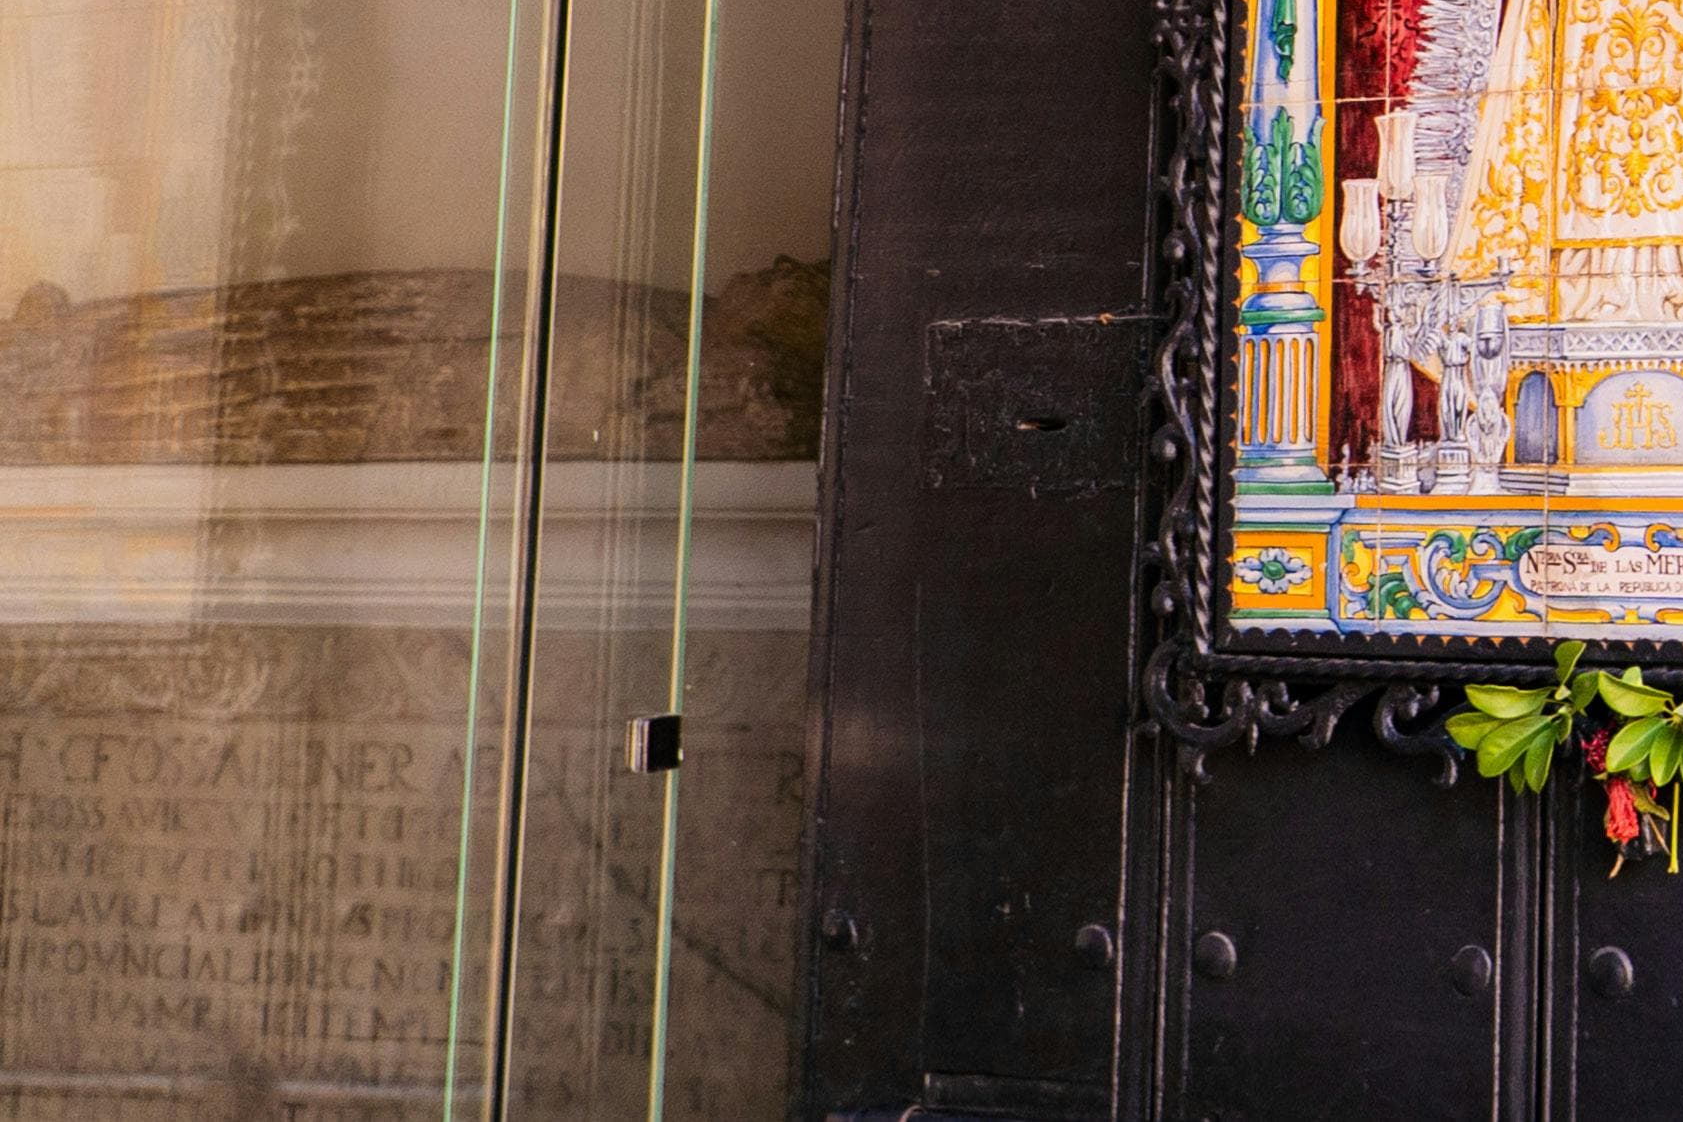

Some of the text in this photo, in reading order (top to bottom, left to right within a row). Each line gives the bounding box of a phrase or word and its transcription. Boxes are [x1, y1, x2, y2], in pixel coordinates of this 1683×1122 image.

[1590, 560, 1608, 574] DE
[1615, 560, 1642, 574] LAS
[1580, 581, 1591, 593] DE
[1597, 582, 1611, 593] LA
